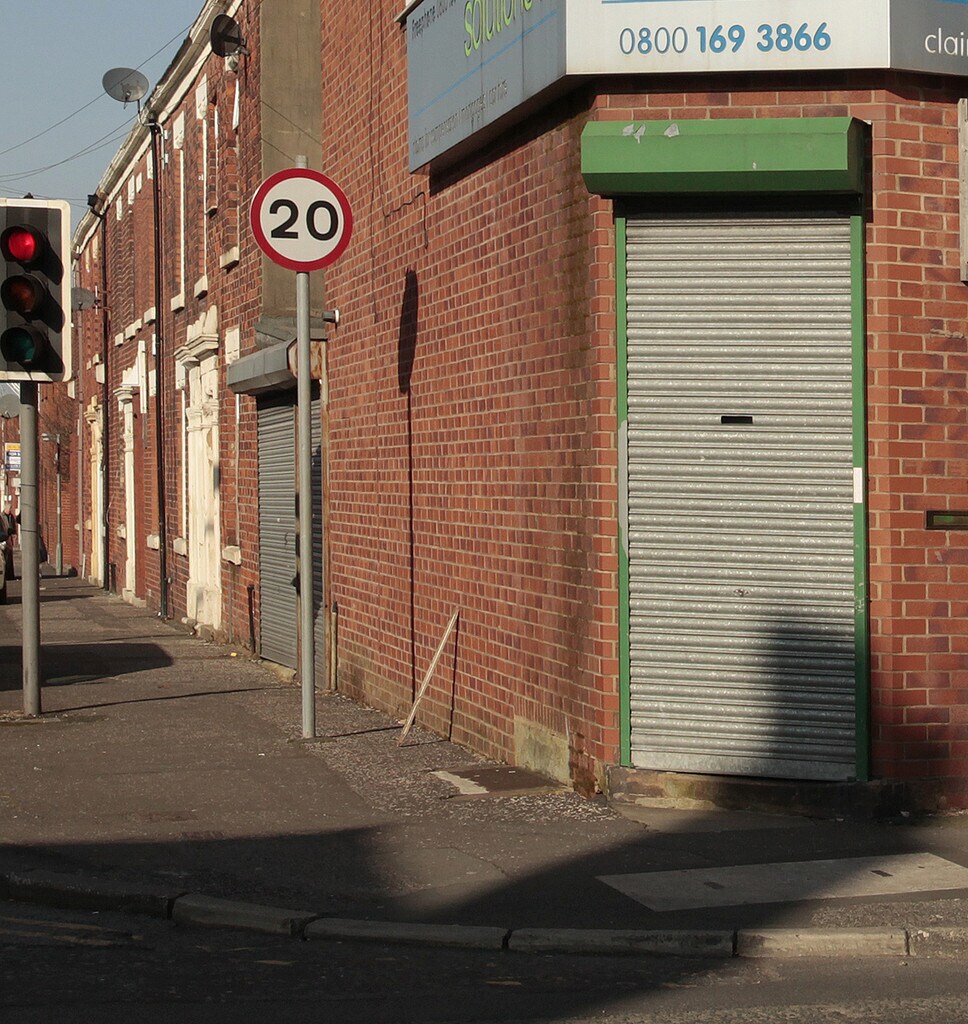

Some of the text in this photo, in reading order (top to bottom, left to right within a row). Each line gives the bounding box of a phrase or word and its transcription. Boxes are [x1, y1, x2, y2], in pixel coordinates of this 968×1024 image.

[619, 22, 831, 55] 0800 169 3866
[269, 198, 339, 241] 20
